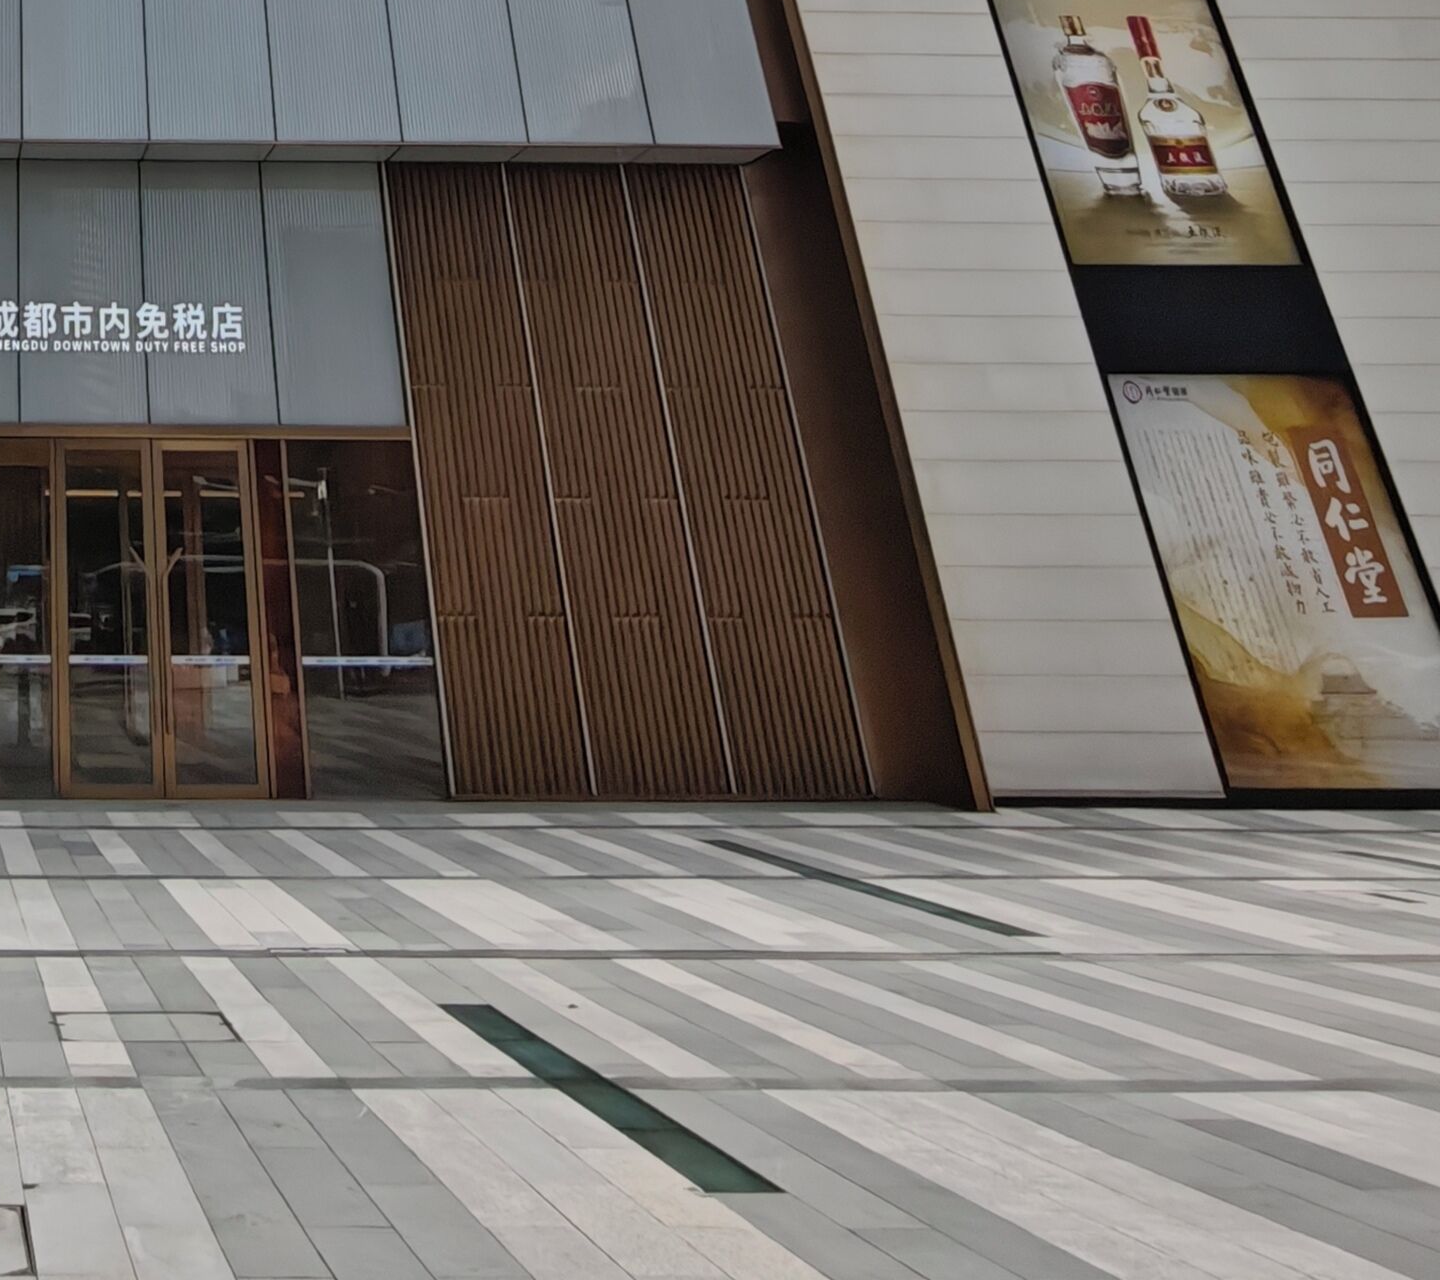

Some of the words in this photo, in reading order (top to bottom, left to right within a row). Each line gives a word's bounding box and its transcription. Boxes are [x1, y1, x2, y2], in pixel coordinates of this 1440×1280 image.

[53, 340, 130, 353] DOWNTOWN
[135, 340, 169, 354] DUTY
[174, 340, 205, 354] FREE
[210, 340, 246, 354] SHOP
[1307, 439, 1388, 605] 同仁堂
